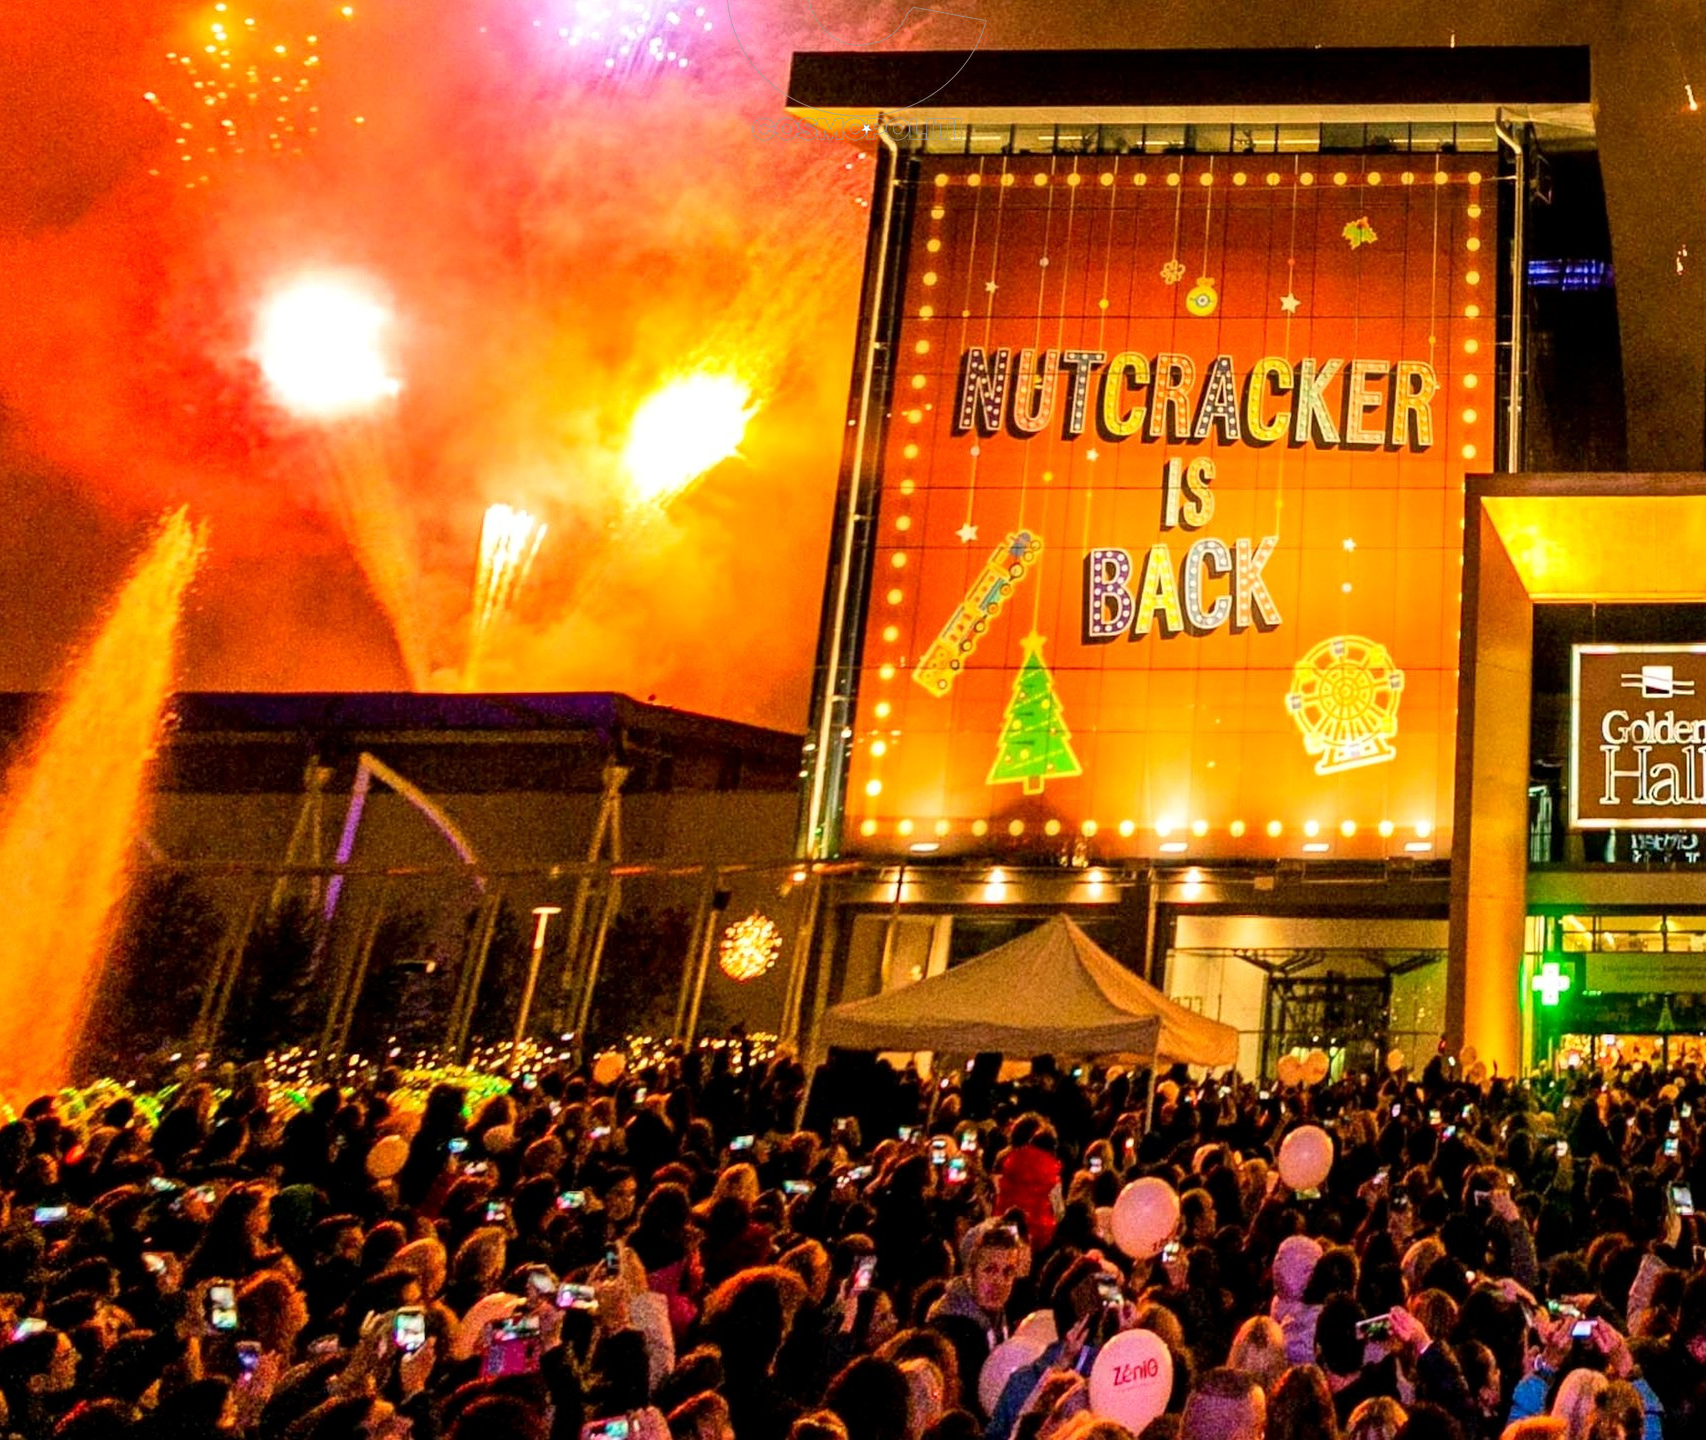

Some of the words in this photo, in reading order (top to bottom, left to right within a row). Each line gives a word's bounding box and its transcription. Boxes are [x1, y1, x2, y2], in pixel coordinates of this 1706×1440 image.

[954, 346, 1437, 451] NUTCRACKER
[1161, 456, 1215, 531] IS
[1082, 535, 1282, 645] BACK
